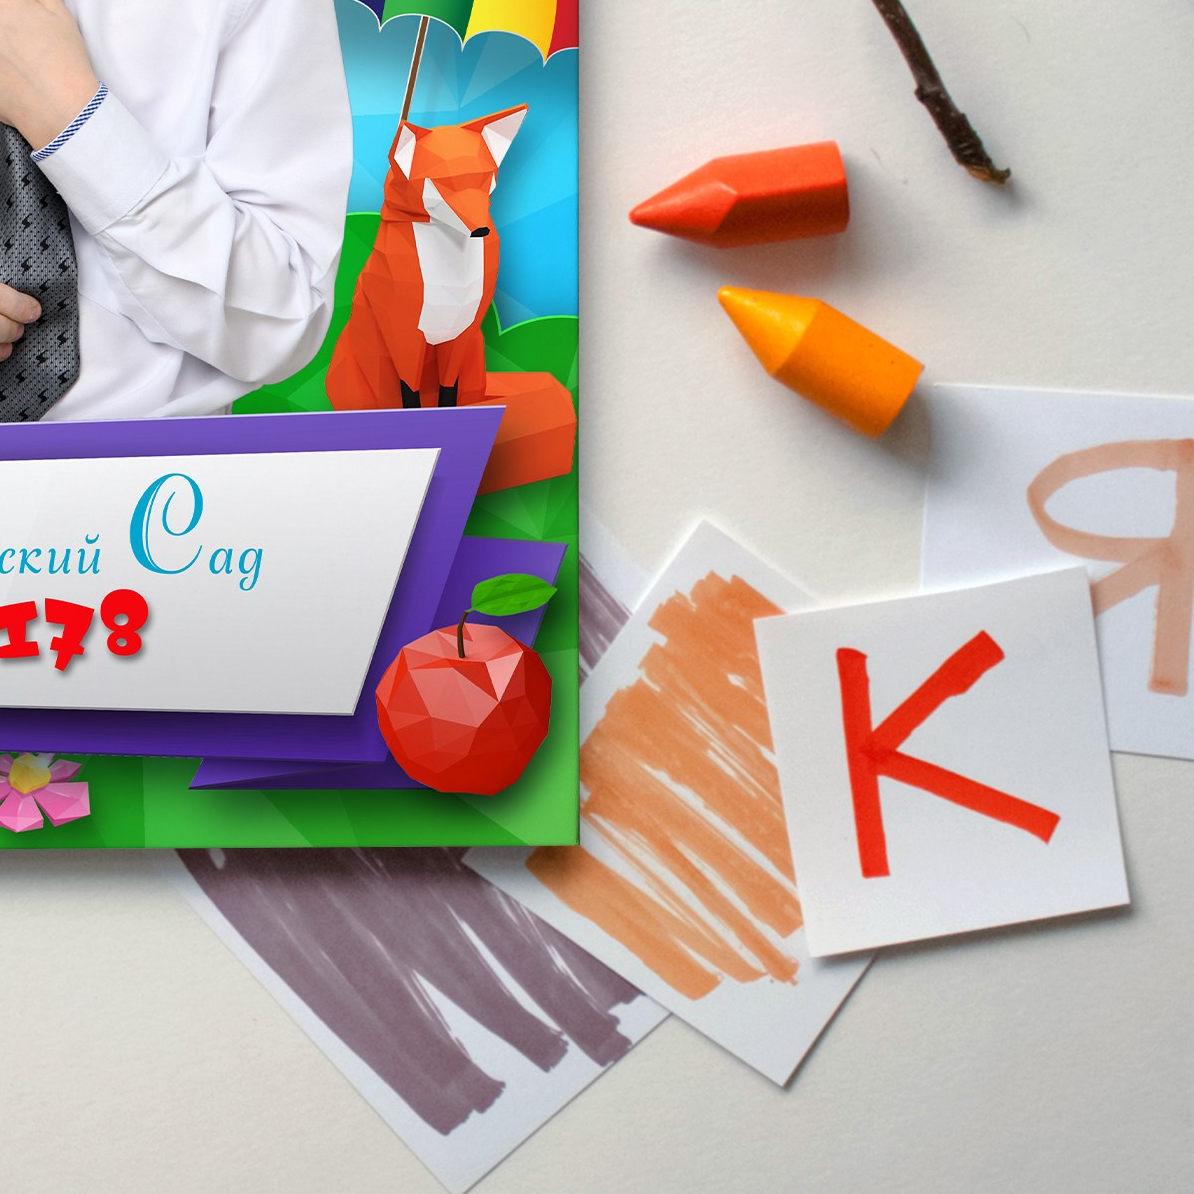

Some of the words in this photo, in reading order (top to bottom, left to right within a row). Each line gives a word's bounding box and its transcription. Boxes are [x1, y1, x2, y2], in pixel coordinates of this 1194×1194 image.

[129, 473, 263, 591] Сад
[1026, 437, 1194, 696] Я
[835, 629, 1062, 881] К
